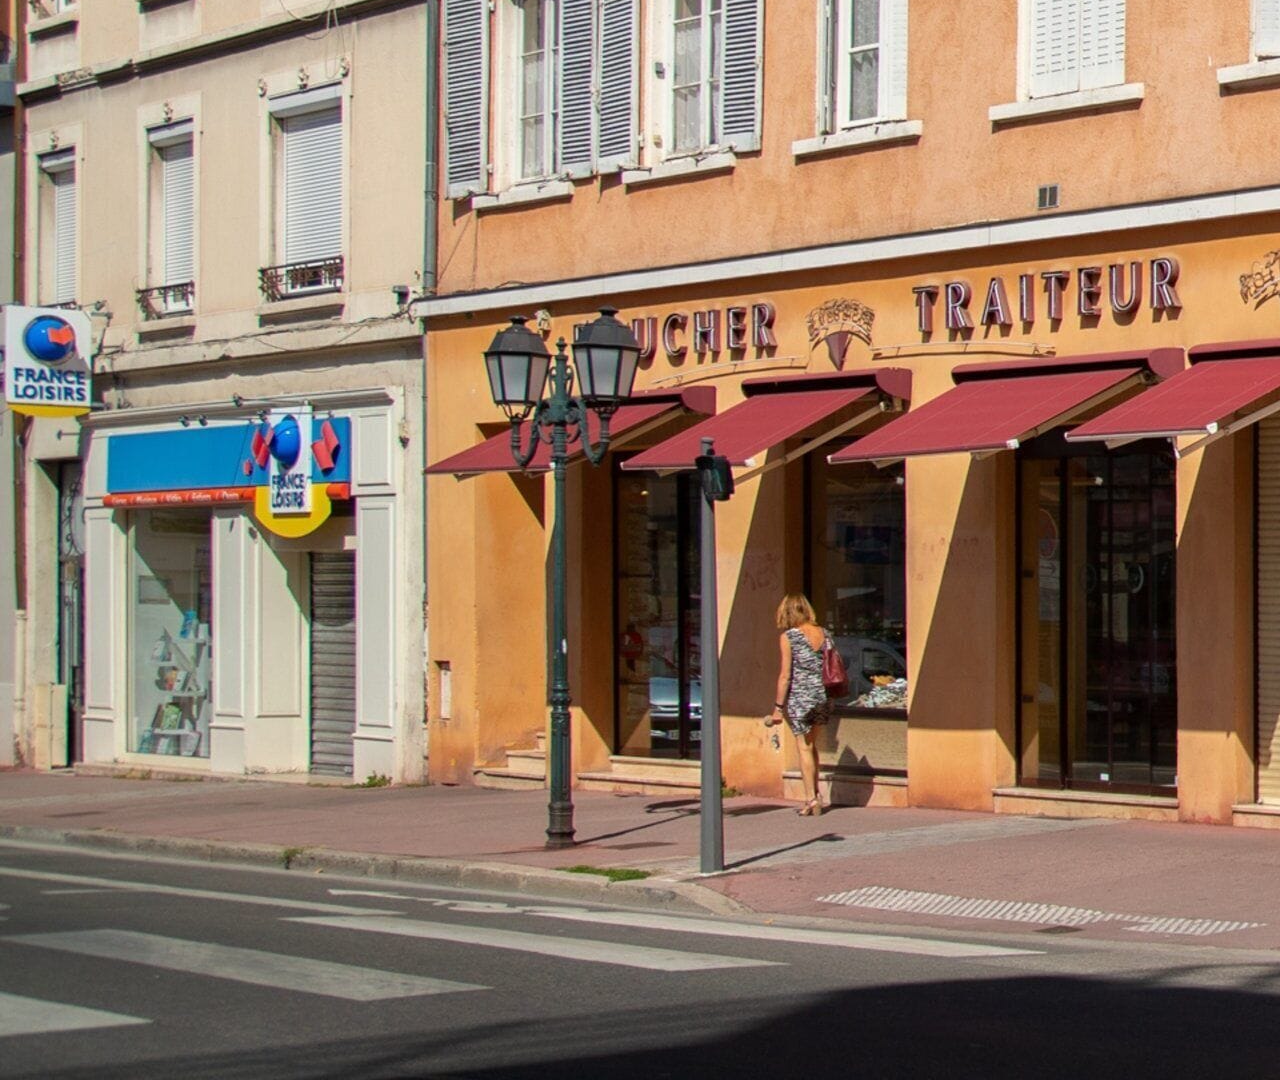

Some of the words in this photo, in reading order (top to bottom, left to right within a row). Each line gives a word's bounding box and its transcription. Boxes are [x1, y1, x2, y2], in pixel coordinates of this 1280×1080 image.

[912, 257, 1183, 333] TRAITEUR
[573, 303, 776, 358] UCHER
[14, 367, 86, 385] FRANCE
[14, 384, 86, 402] LOISIRS
[272, 474, 304, 489] FRANCE
[272, 491, 304, 508] LOISIRS
